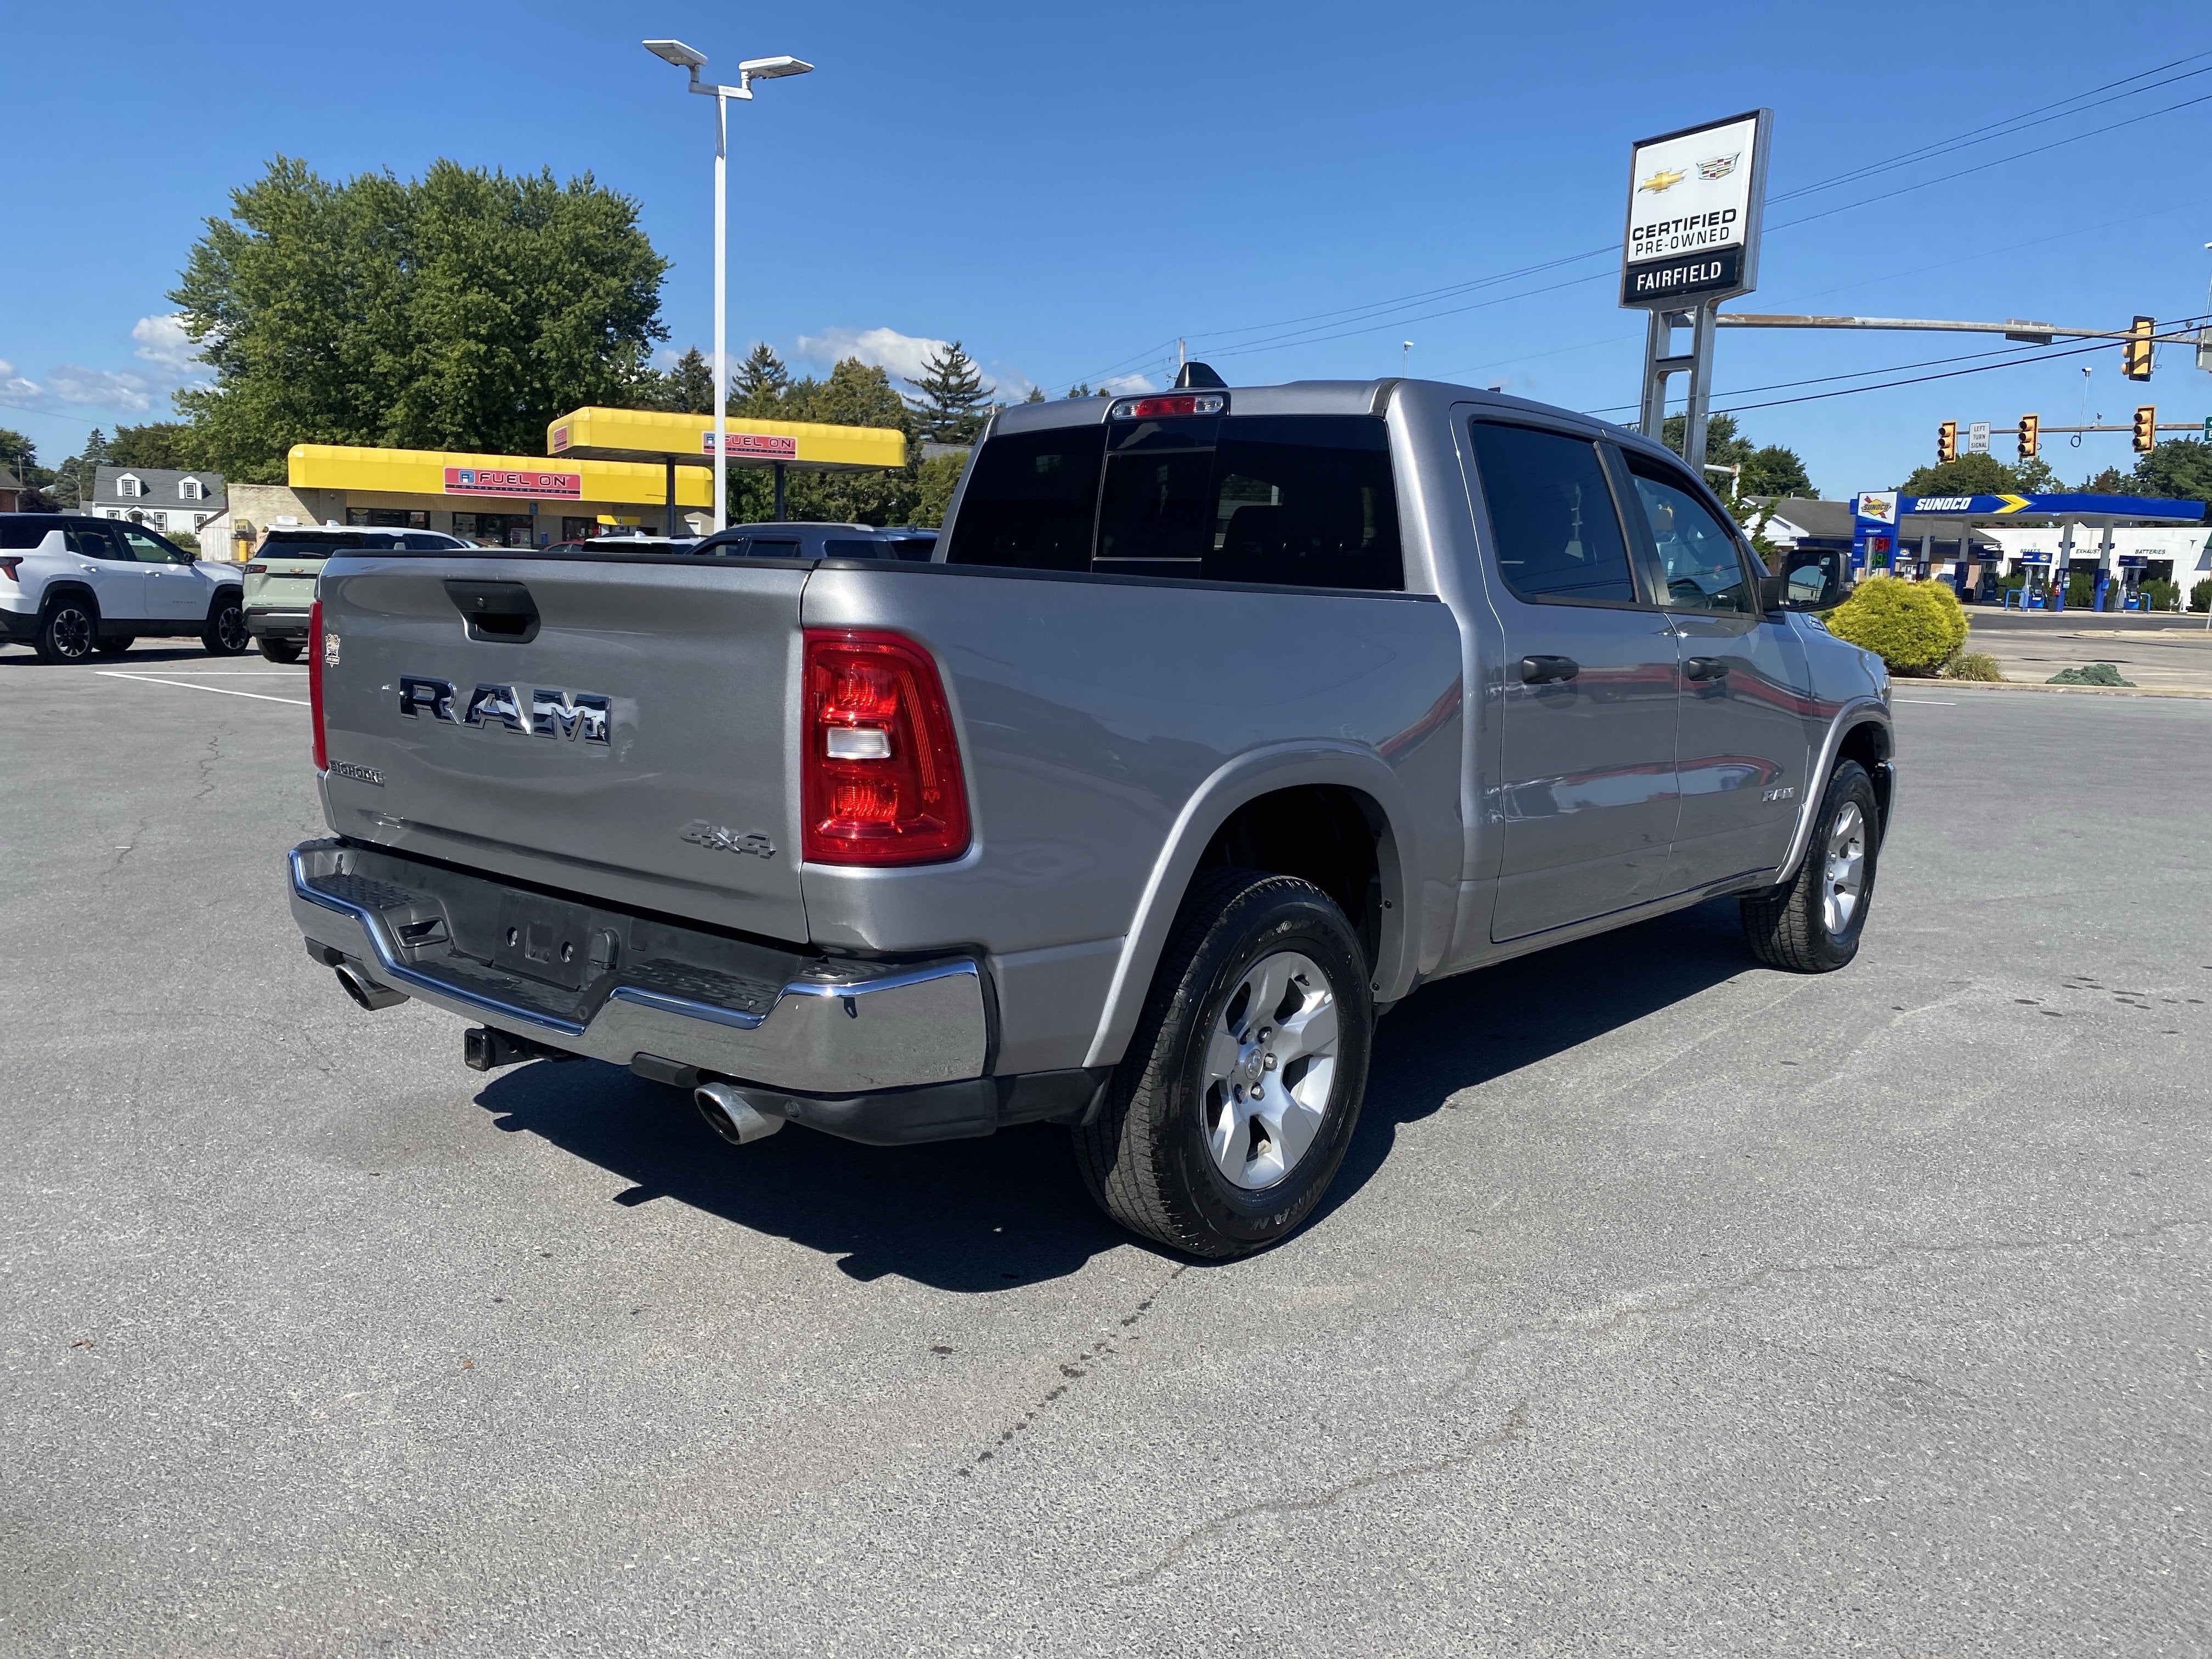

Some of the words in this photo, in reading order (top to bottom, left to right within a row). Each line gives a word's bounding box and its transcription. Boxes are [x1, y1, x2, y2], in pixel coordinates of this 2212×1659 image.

[1632, 208, 1736, 241] CERTIFIED
[1636, 227, 1729, 256] PRE-OWNED
[1637, 261, 1721, 291] FAIRFIELD
[769, 438, 791, 448] ON
[479, 473, 530, 485] FUEL
[539, 475, 566, 486] ON
[1915, 497, 1972, 511] SUNOCO
[399, 675, 612, 747] RAM
